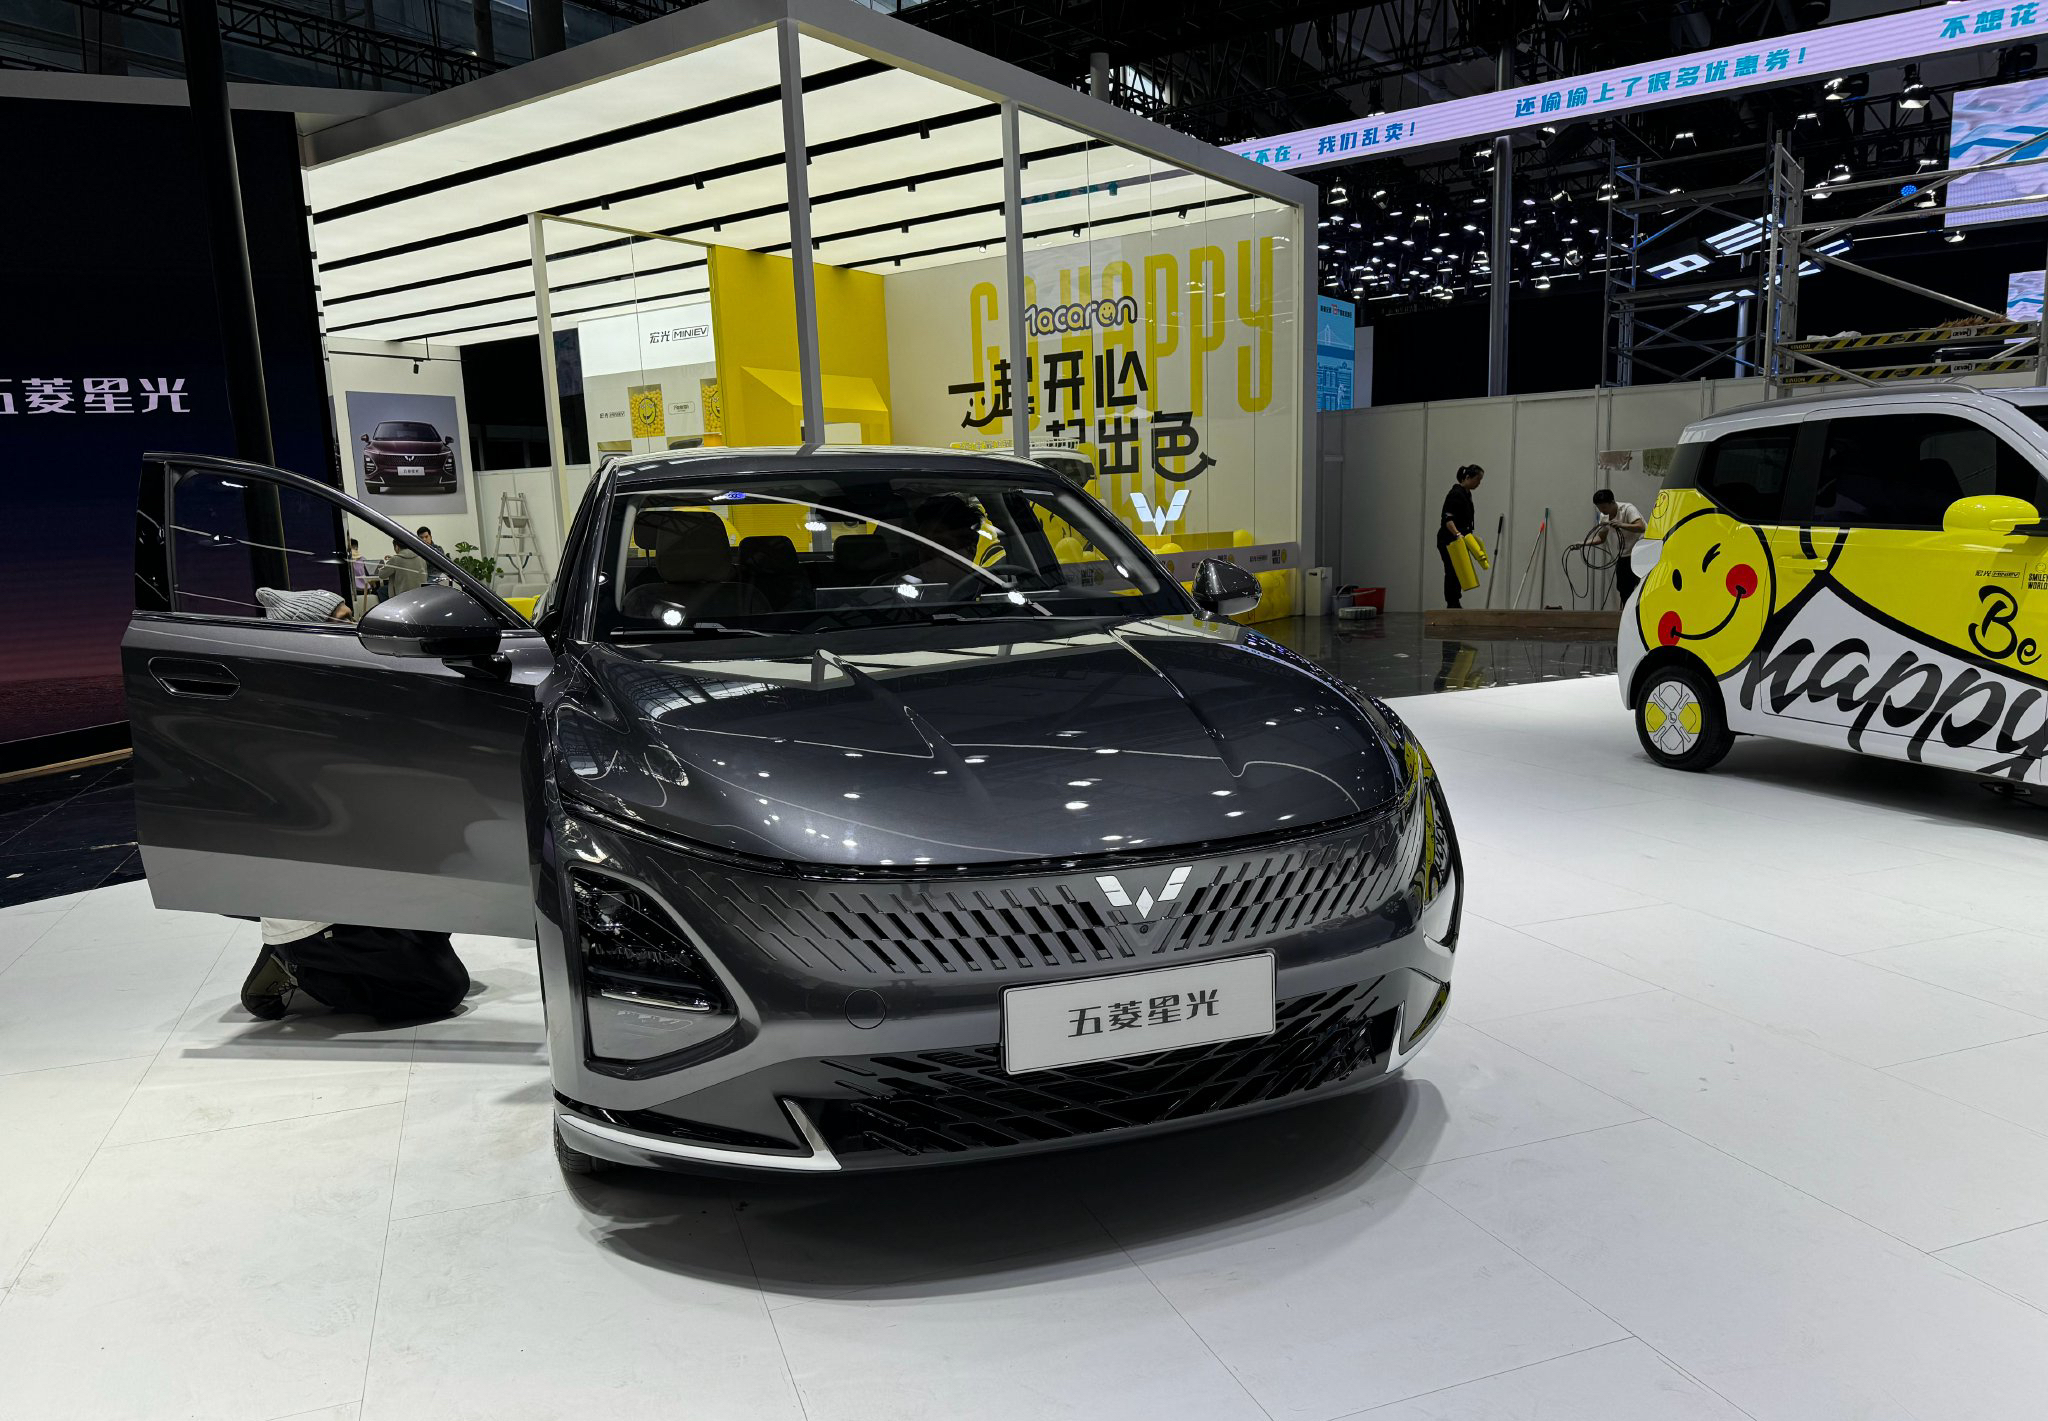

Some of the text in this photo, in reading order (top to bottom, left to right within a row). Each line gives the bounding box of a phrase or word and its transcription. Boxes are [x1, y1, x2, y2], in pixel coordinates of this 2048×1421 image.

[649, 326, 708, 344] 宏光 MINIEV
[1059, 236, 1274, 427] HAPPY
[1968, 585, 2042, 666] Be
[1740, 638, 2048, 782] happy
[1068, 989, 1220, 1037] 五菱星光
